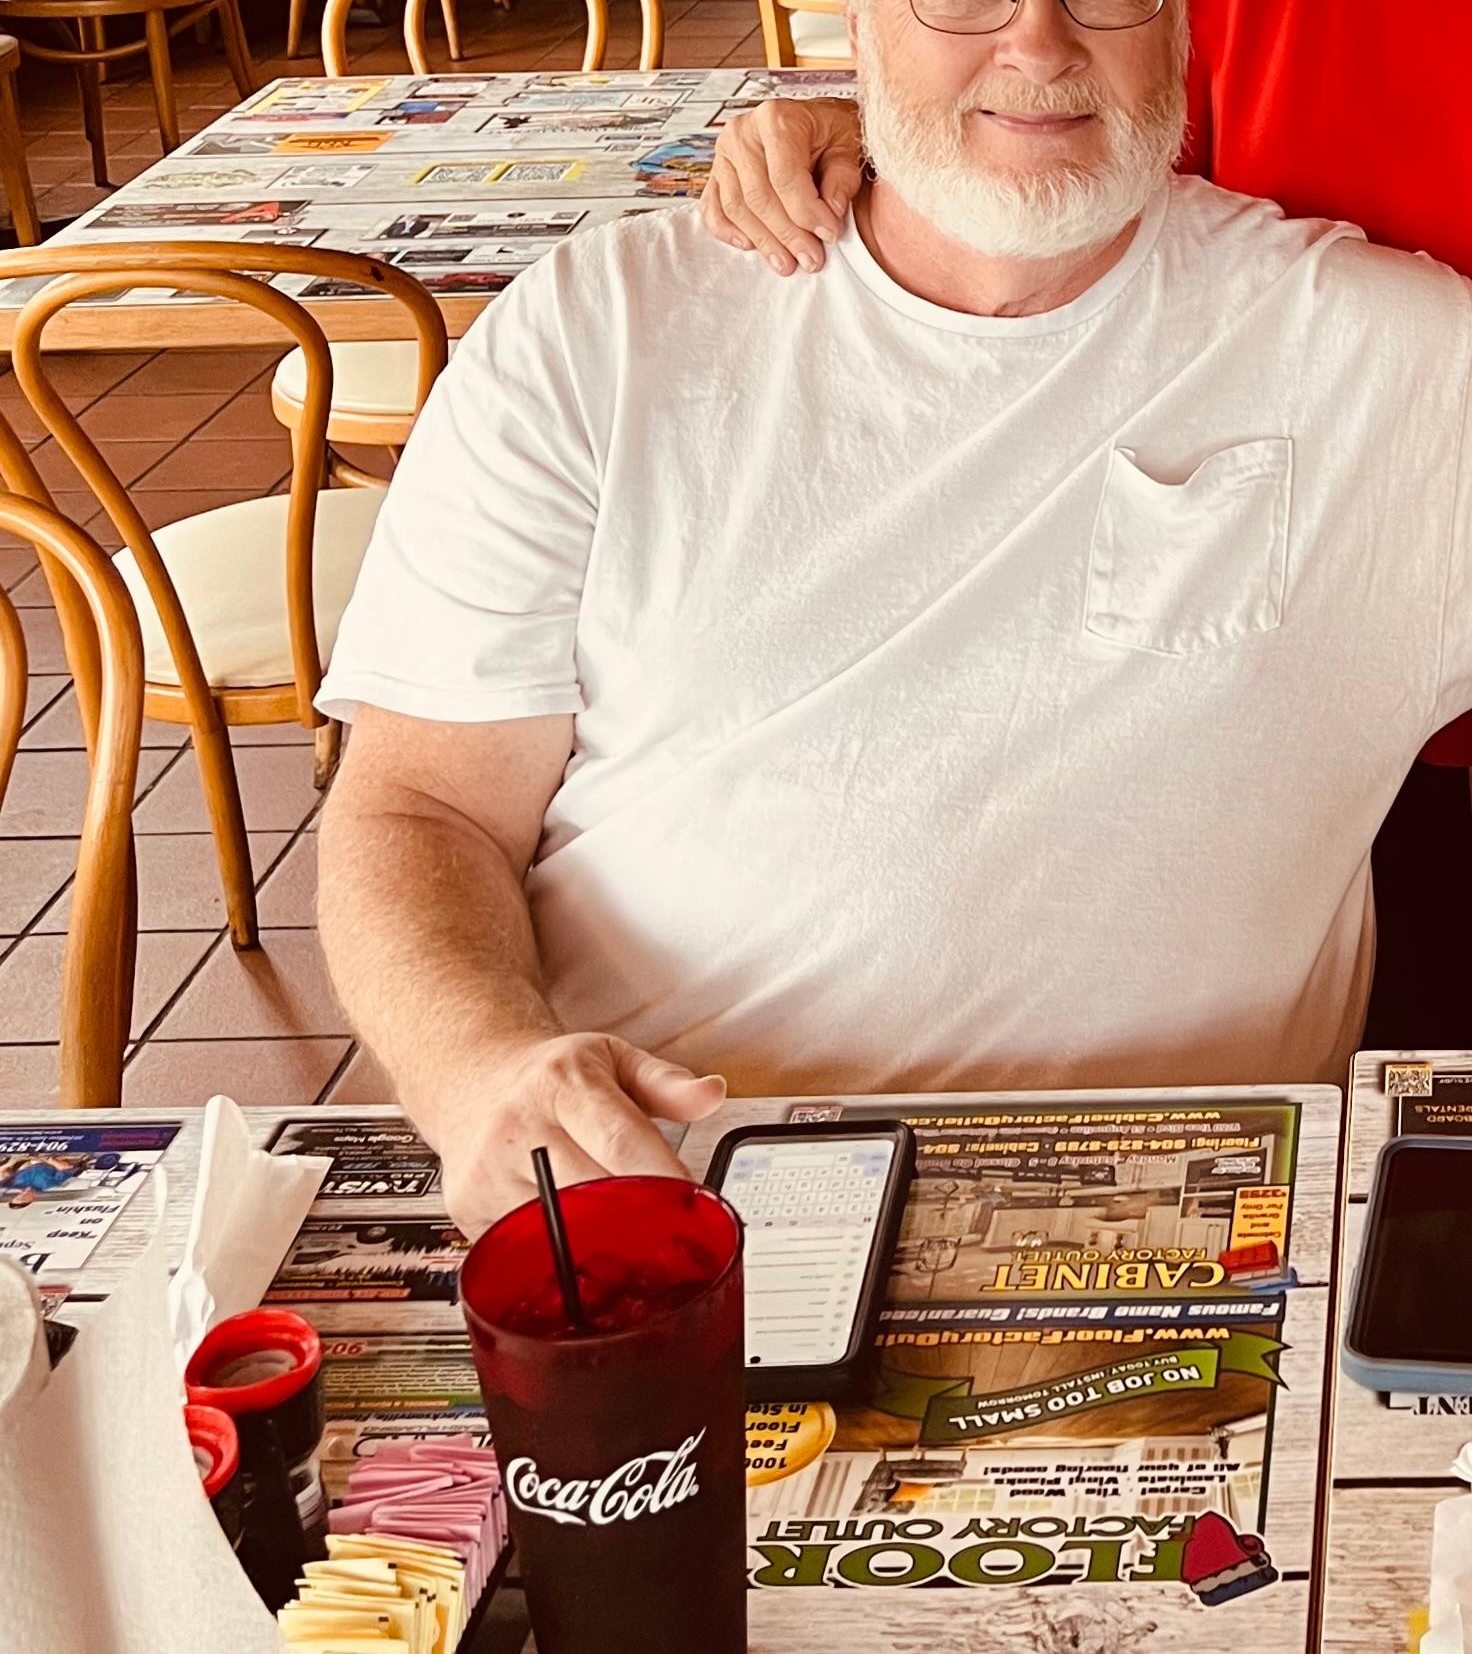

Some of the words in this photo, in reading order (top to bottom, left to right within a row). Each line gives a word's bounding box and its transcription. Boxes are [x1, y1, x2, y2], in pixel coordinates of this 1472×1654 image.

[901, 1111, 1220, 1126] www.CabinetFactoryOutlet.co
[1427, 1114, 1472, 1123] BOARD
[333, 1134, 366, 1144] Maps
[367, 1134, 413, 1144] Google
[1191, 1137, 1261, 1151] Flooring:
[0, 1141, 69, 1152] 904-829
[916, 1143, 960, 1154] 904-
[965, 1142, 1039, 1155] Cabinets:
[318, 1180, 420, 1195] TWIST
[44, 1204, 121, 1215] Flushin"
[79, 1217, 104, 1226] on
[46, 1229, 97, 1240] "Keep
[1012, 1248, 1101, 1264] OUTLET
[1106, 1247, 1208, 1263] FACTORY
[979, 1260, 1226, 1294] CABINET
[878, 1308, 1011, 1324] Guaranteed
[1016, 1305, 1109, 1322] Brands!
[1115, 1303, 1182, 1319] Name
[1187, 1301, 1281, 1318] Famous
[1153, 1354, 1179, 1367] BUY
[1051, 1368, 1106, 1392] INSTALL
[1160, 1363, 1202, 1386] NO
[1103, 1367, 1157, 1398] JOB
[976, 1384, 1050, 1409] TOMORROW
[1046, 1382, 1104, 1413] TOO
[788, 1404, 808, 1416] In
[947, 1397, 1044, 1431] SMALL
[374, 1412, 463, 1422] Jacksonville,
[745, 1421, 801, 1434] Floor
[747, 1439, 788, 1451] Fee
[1054, 1462, 1130, 1476] flooring
[1137, 1462, 1181, 1474] your
[1185, 1463, 1207, 1476] of
[1213, 1463, 1241, 1475] All
[506, 1426, 706, 1525] Coca-Cola
[1067, 1473, 1119, 1488] Vinyl
[1137, 1474, 1227, 1487] Laminate
[992, 1477, 1062, 1488] Planks
[1008, 1488, 1068, 1500] Wood
[1084, 1486, 1123, 1499] Tile
[1141, 1486, 1207, 1499] Carpet
[755, 1520, 943, 1543] OUTLET
[953, 1515, 1197, 1541] FACTORY
[752, 1539, 1184, 1589] FLOOR
